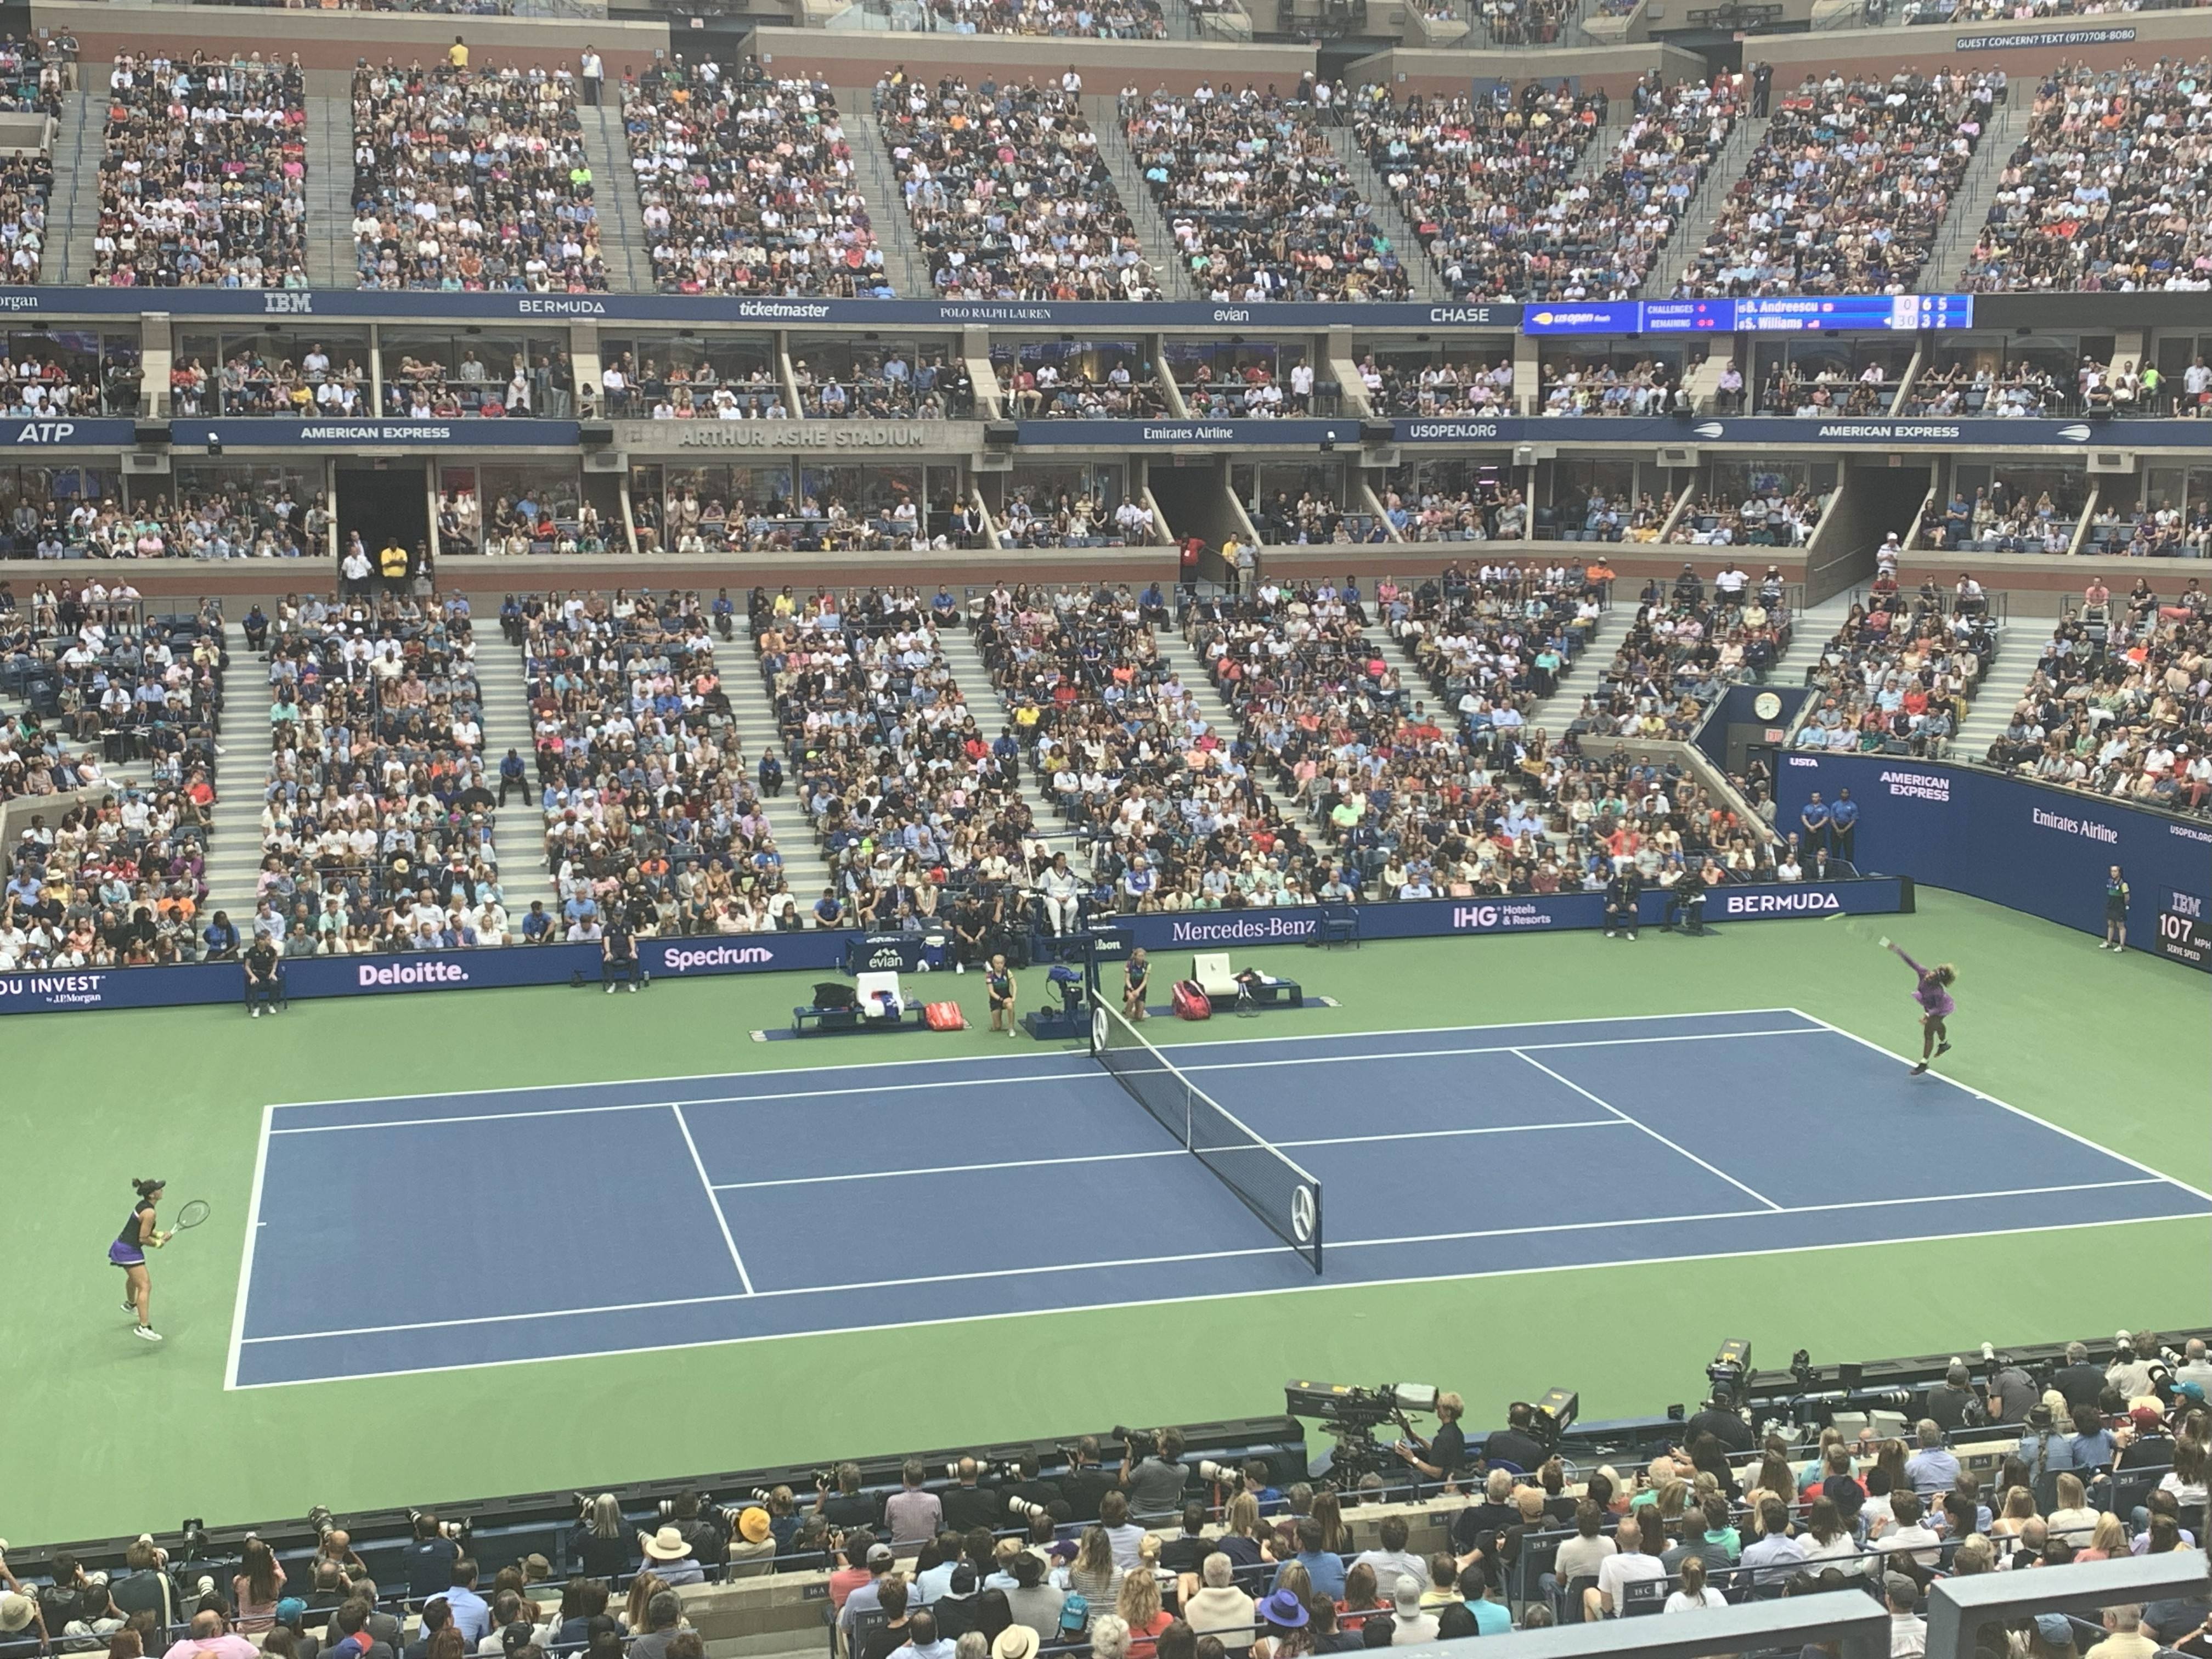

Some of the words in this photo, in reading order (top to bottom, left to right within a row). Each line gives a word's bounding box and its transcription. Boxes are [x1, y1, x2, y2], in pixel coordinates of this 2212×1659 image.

[1957, 35, 1987, 48] GUEST
[1988, 35, 2039, 47] CONCERN?
[2040, 33, 2064, 43] TEXT
[2065, 28, 2135, 42] (917)708-8080
[264, 292, 312, 312] IBM
[519, 300, 605, 313] BERMUDA
[740, 301, 830, 317] ticketmaster
[1647, 304, 1694, 314] CHALLENGES
[1759, 300, 1818, 313] Andreescu
[1922, 297, 1932, 311] 6
[1938, 297, 1947, 311] 5
[940, 308, 969, 318] POLO
[972, 308, 1007, 318] RALPH
[1009, 309, 1051, 319] LAUREN
[1214, 307, 1249, 321] evian
[1431, 308, 1489, 322] CHASE
[1899, 315, 1915, 327] 30
[1921, 314, 1931, 328] 3
[1937, 313, 1946, 328] 2
[1651, 319, 1691, 328] REMAINING
[1758, 316, 1803, 329] Williams
[17, 423, 74, 442] ATP
[301, 427, 379, 438] AMERICAN
[383, 427, 450, 438] EXPRESS
[679, 428, 763, 447] ARTHUR
[770, 428, 826, 447] ASHE
[834, 427, 924, 447] STADIUM
[1144, 427, 1192, 439] Emirates
[1195, 427, 1233, 438] Airline
[1410, 424, 1497, 437] USOPEN.ORG
[1819, 426, 1891, 437] AMERICAN
[1895, 426, 1959, 437] EXPRESS
[1790, 757, 1818, 767] USTA
[1880, 771, 1949, 789] AMERICAN
[1891, 784, 1949, 802] EXPRESS
[2033, 808, 2078, 833] Emirates
[2079, 820, 2118, 844] Airline
[2170, 825, 2212, 843] USOPEN.ORG
[1503, 904, 1536, 916] Hotels
[1728, 893, 1839, 913] BERMUDA
[2171, 892, 2201, 917] IBM
[1454, 906, 1498, 928] IHG
[1503, 917, 1511, 926] &
[1513, 915, 1551, 925] Resorts
[1172, 918, 1316, 941] Mercedes-Benz
[2160, 911, 2192, 942] 107
[2194, 937, 2211, 950] MPH
[664, 946, 766, 972] Spectrum
[2167, 943, 2183, 956] SERVE
[2183, 949, 2200, 961] SPEED
[869, 954, 903, 968] evian
[359, 961, 469, 986] Deloitte.
[31, 975, 100, 994] INVEST
